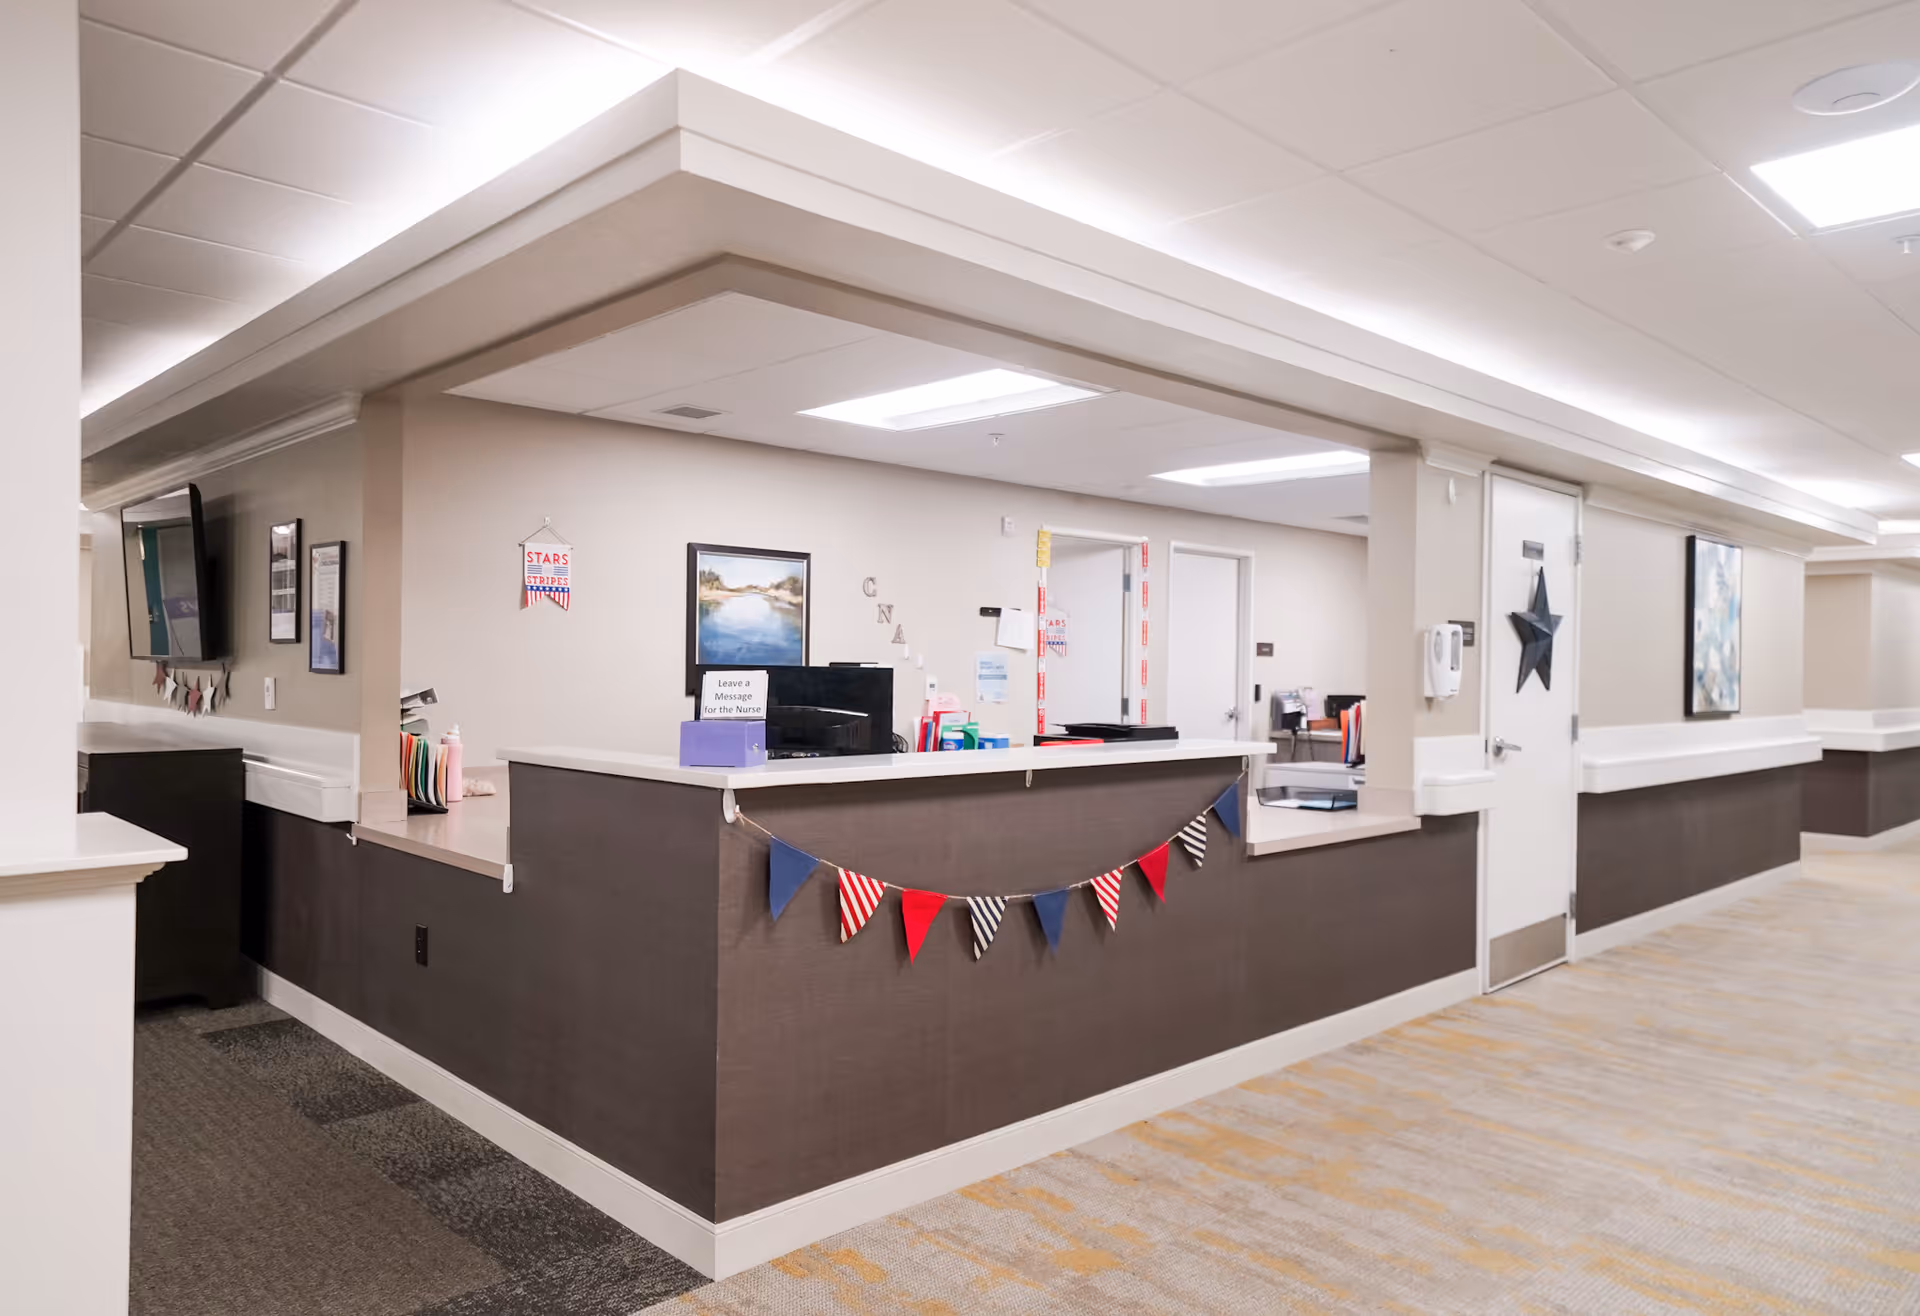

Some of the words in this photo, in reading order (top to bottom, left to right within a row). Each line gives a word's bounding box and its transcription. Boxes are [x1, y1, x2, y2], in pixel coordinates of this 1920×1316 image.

[527, 551, 568, 565] STARS
[527, 575, 568, 586] STRIPES
[714, 692, 753, 702] Message
[704, 705, 717, 713] for
[719, 705, 734, 713] the
[736, 705, 762, 713] Nurse
